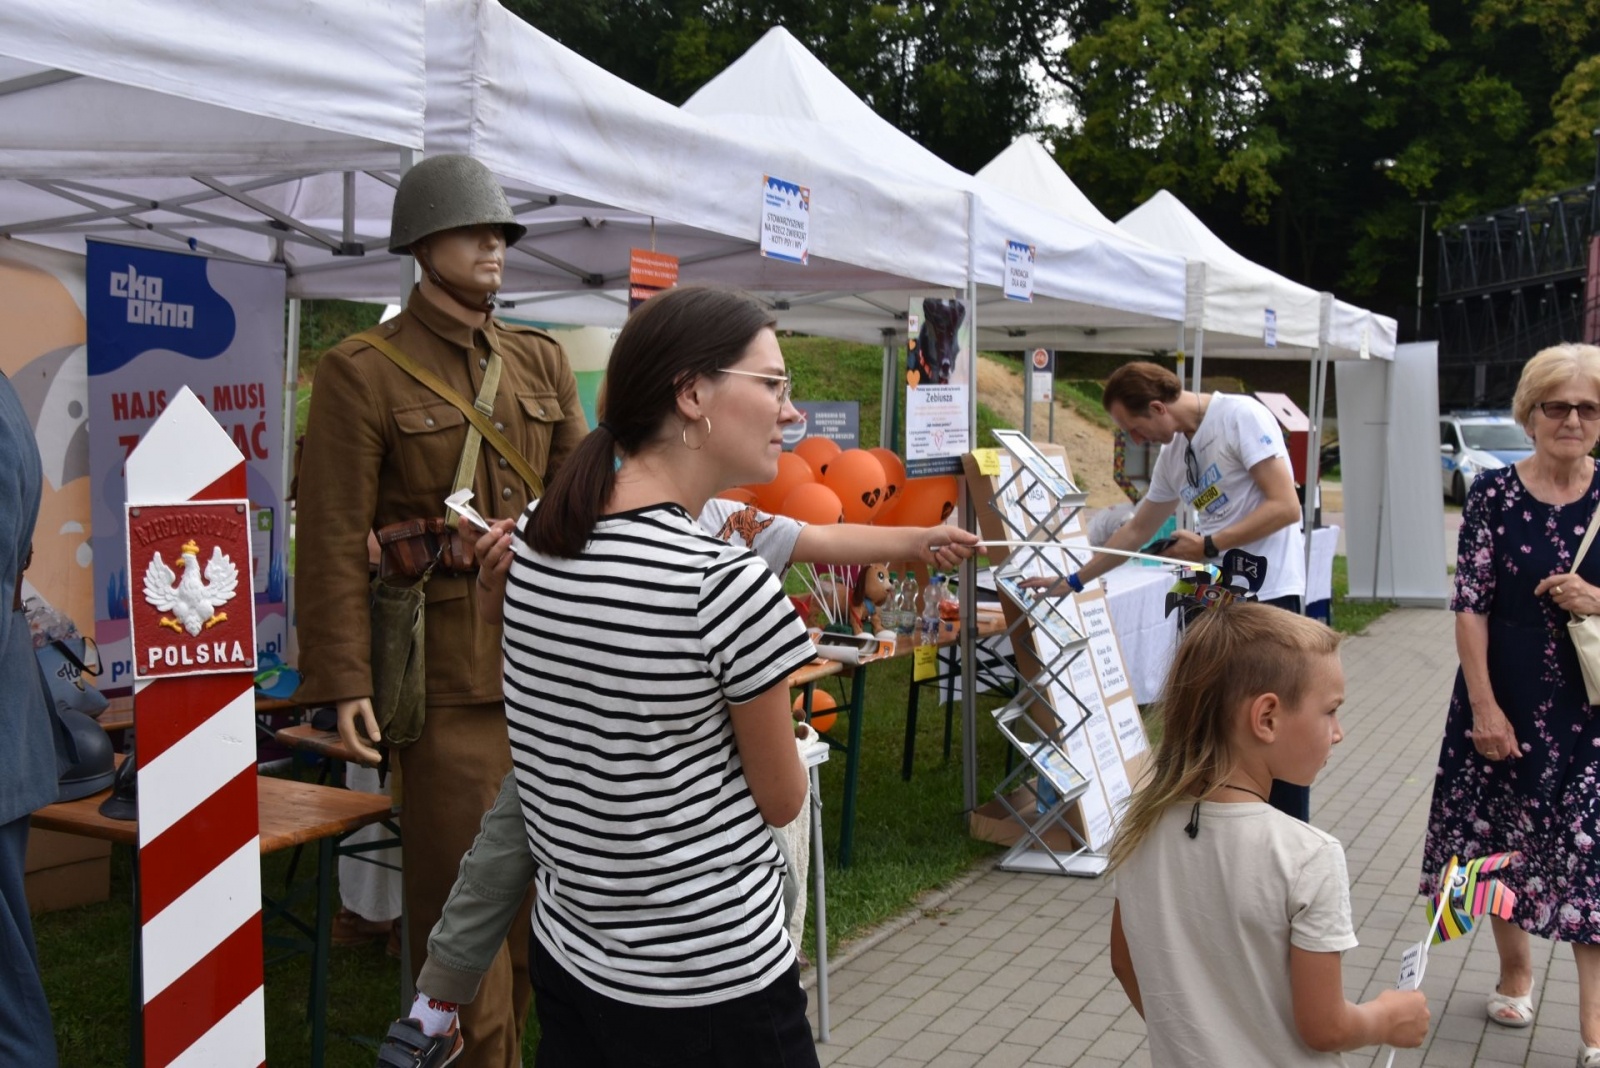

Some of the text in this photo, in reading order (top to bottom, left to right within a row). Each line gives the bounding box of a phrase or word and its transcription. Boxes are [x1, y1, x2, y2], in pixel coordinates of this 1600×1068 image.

[767, 213, 804, 229] STOWARZYSZENIE
[111, 390, 167, 421] HAJS
[214, 383, 266, 412] MUSI
[148, 641, 245, 669] POLSKA
